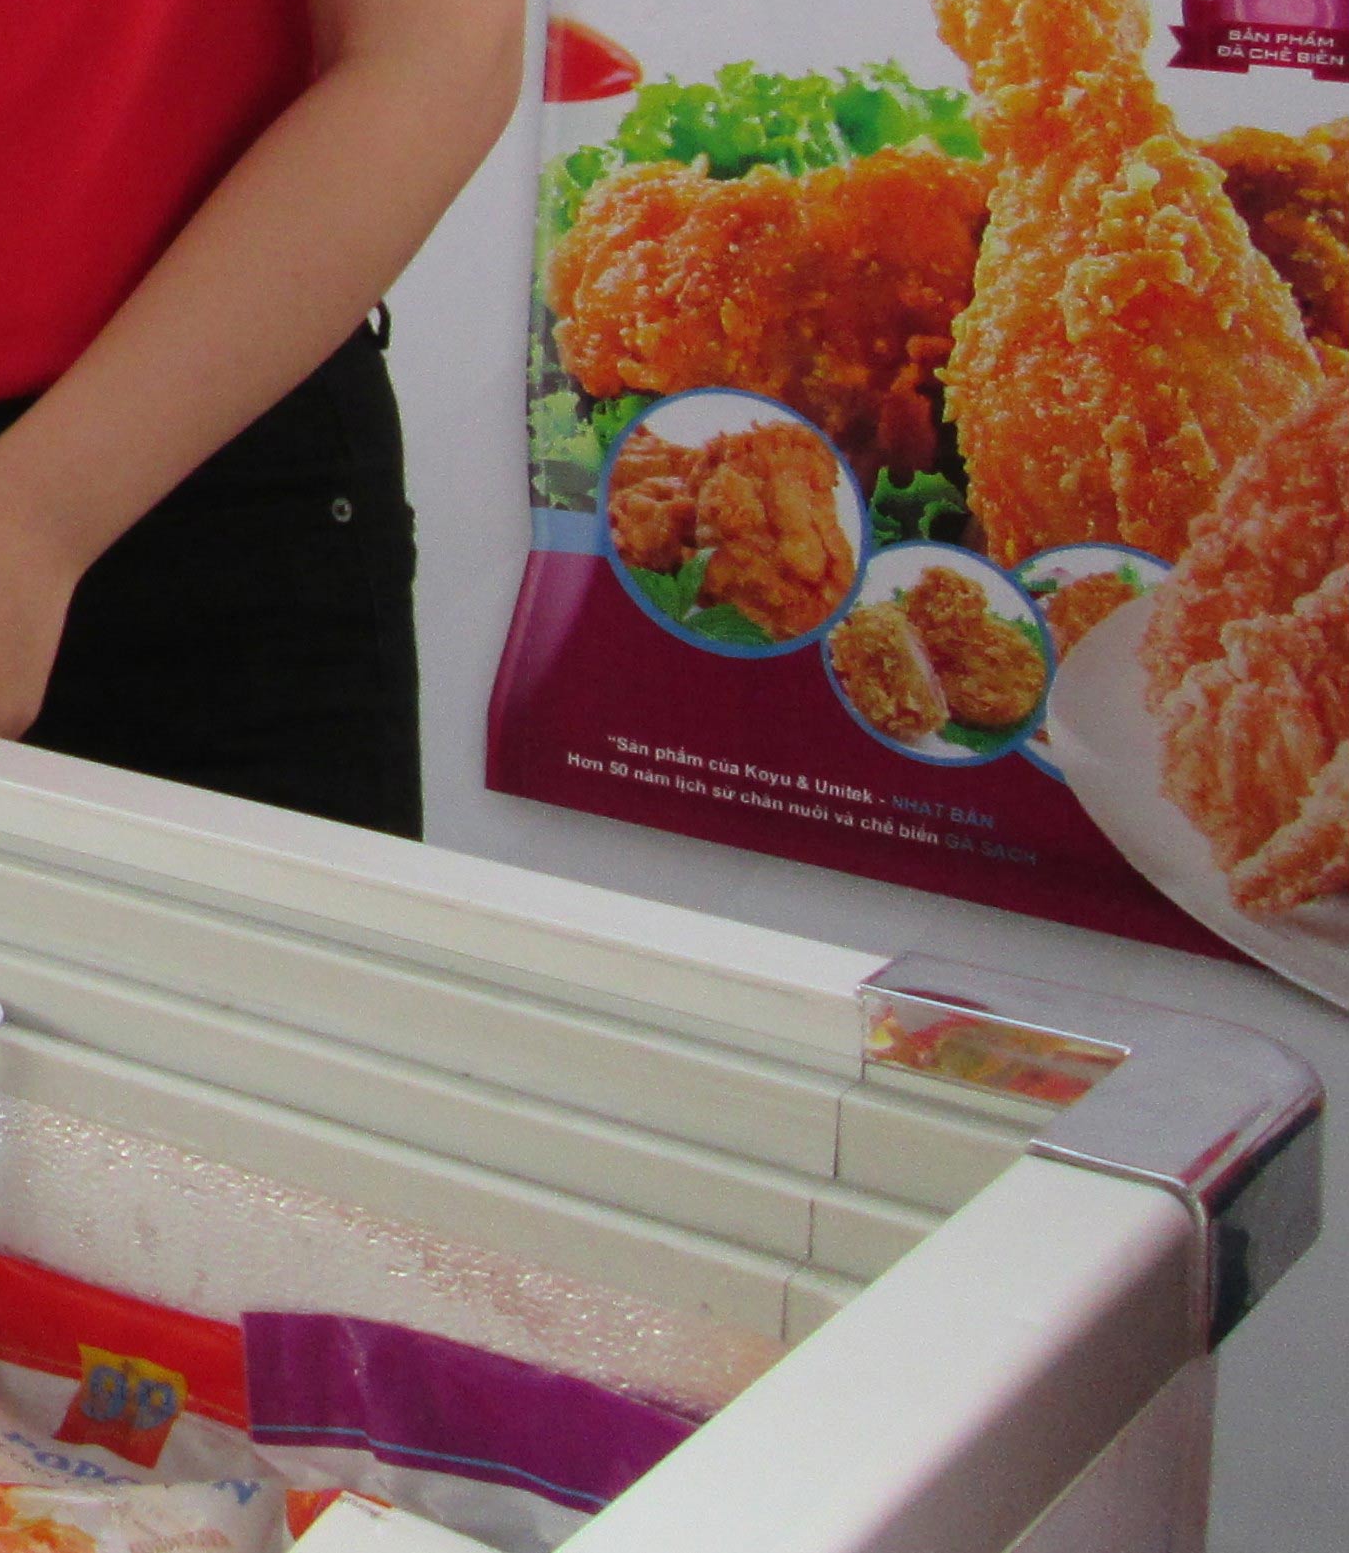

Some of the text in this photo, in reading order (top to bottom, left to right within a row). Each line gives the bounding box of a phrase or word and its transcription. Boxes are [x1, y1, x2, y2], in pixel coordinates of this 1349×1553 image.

[567, 751, 604, 773] Hơn
[608, 760, 630, 778] 50
[675, 775, 707, 794] lịch
[834, 809, 854, 827] và
[708, 758, 740, 776] của
[744, 762, 791, 787] Koyu
[795, 774, 810, 790] &
[814, 777, 874, 805] Unitek
